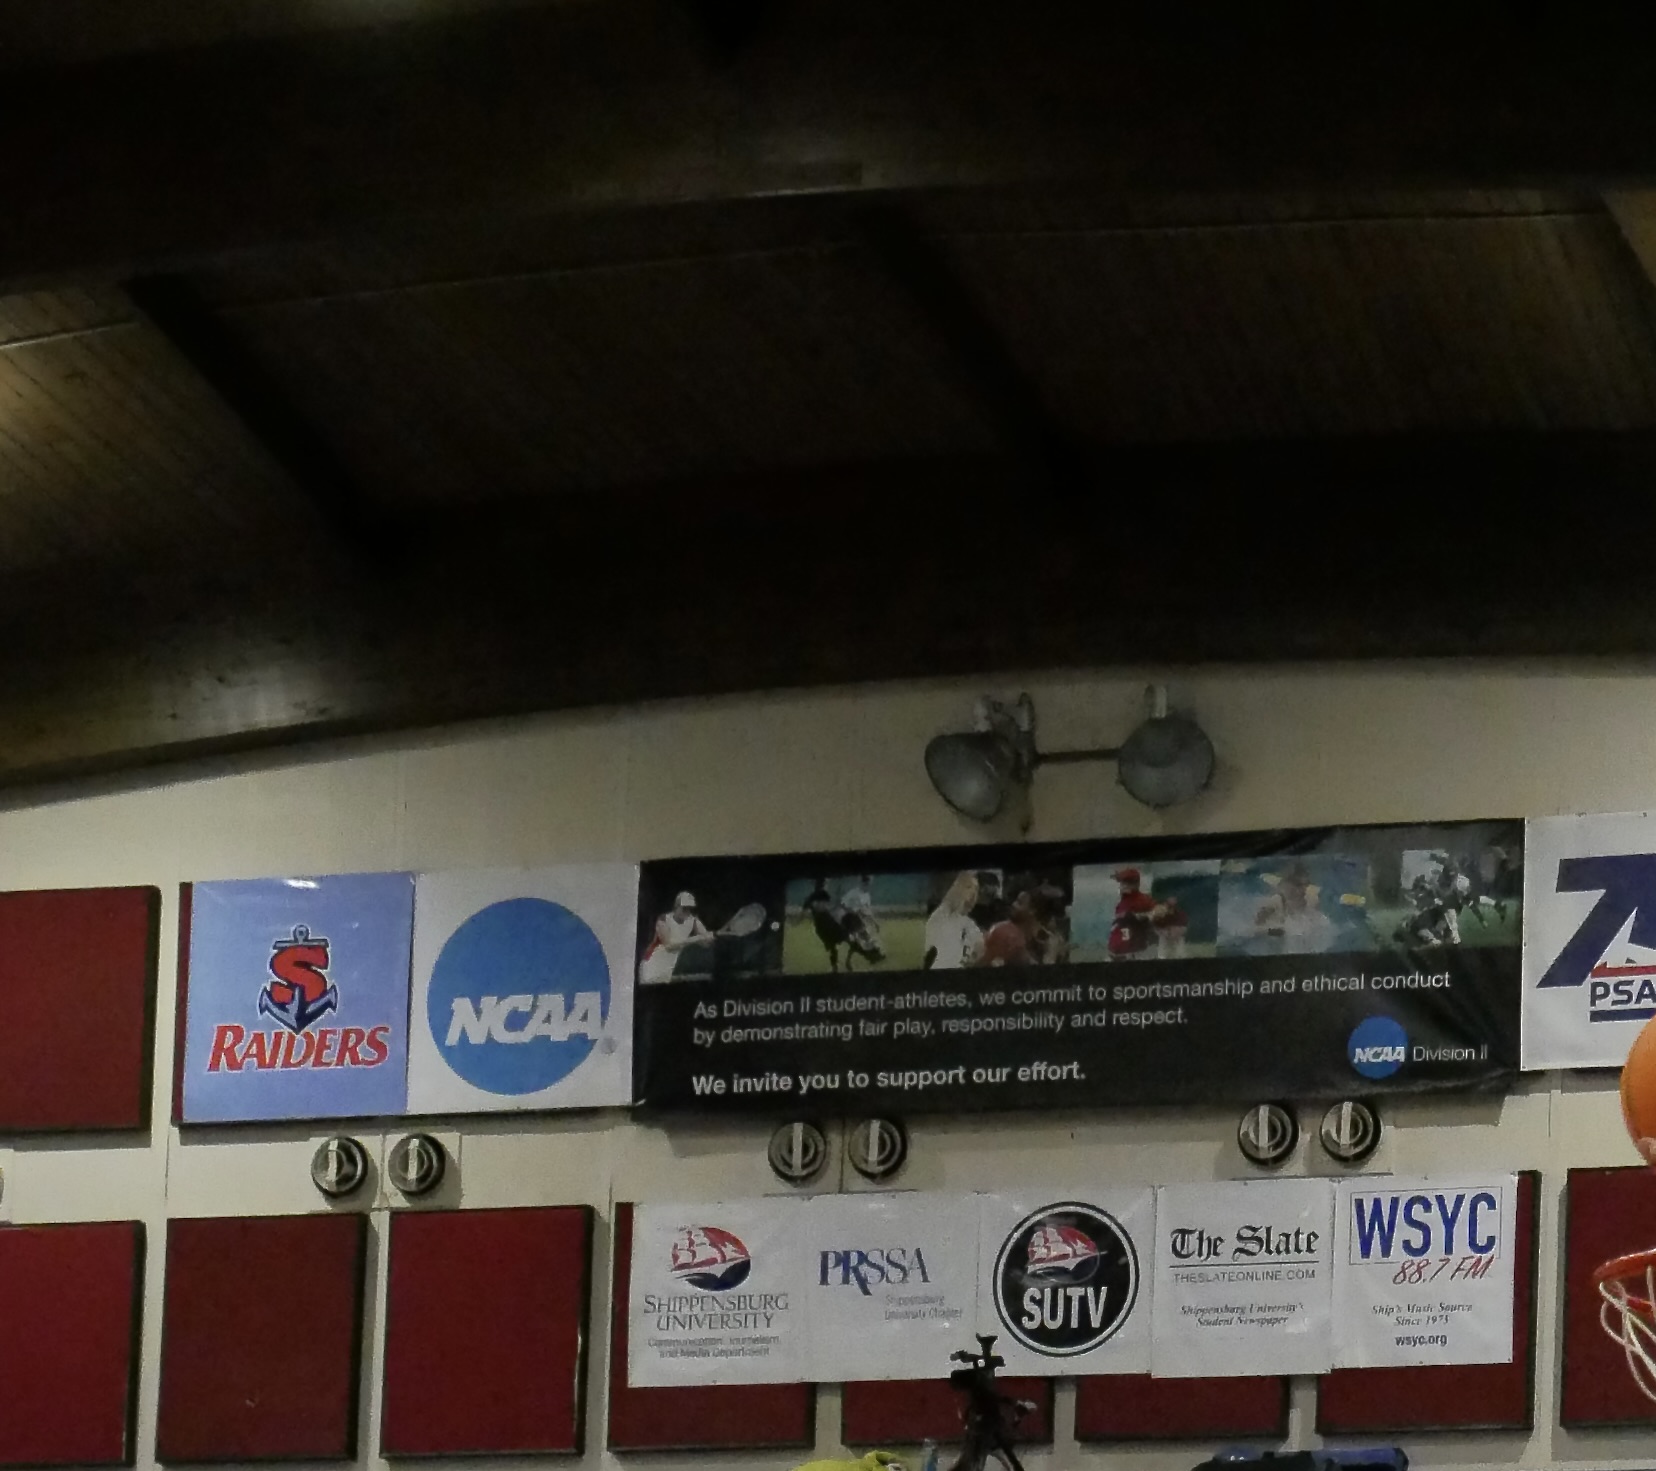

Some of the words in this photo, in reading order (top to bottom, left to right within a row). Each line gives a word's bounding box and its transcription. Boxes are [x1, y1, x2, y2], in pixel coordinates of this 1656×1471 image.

[693, 1001, 718, 1019] As
[723, 998, 794, 1018] Division
[816, 990, 973, 1013] student-athletes,
[979, 991, 1006, 1006] we
[1011, 984, 1083, 1005] commit
[1088, 983, 1107, 1001] to
[1113, 977, 1254, 1003] sportsmanship
[1259, 976, 1296, 995] and
[1302, 972, 1366, 991] ethical
[1371, 970, 1451, 991] conduct
[444, 989, 606, 1048] NCAA
[693, 1026, 716, 1048] by
[720, 1020, 853, 1044] demonstrating
[858, 1018, 888, 1037] fair
[893, 1016, 937, 1039] play,
[941, 1011, 1065, 1036] responsibility
[1071, 1011, 1107, 1028] and
[1112, 1007, 1189, 1030] respect.
[207, 1024, 391, 1073] RAIDERS
[1352, 1046, 1405, 1064] NCAA
[1412, 1045, 1476, 1063] Division
[692, 1074, 726, 1095] We
[731, 1072, 793, 1093] invite
[798, 1072, 840, 1094] you
[847, 1070, 870, 1089] to
[876, 1065, 966, 1090] support
[972, 1065, 1012, 1084] our
[1017, 1060, 1087, 1082] effort.
[1169, 1227, 1225, 1262] The
[1231, 1224, 1320, 1263] Slate
[1354, 1192, 1497, 1260] WSYC
[818, 1247, 931, 1296] PRSSA
[1392, 1257, 1450, 1285] 88.7
[1449, 1253, 1494, 1281] FM
[643, 1293, 790, 1315] SHIPPENSBURG
[656, 1312, 775, 1332] UNIVERSITY
[1021, 1286, 1109, 1331] SUTV
[1394, 1333, 1448, 1348] wsyc.org
